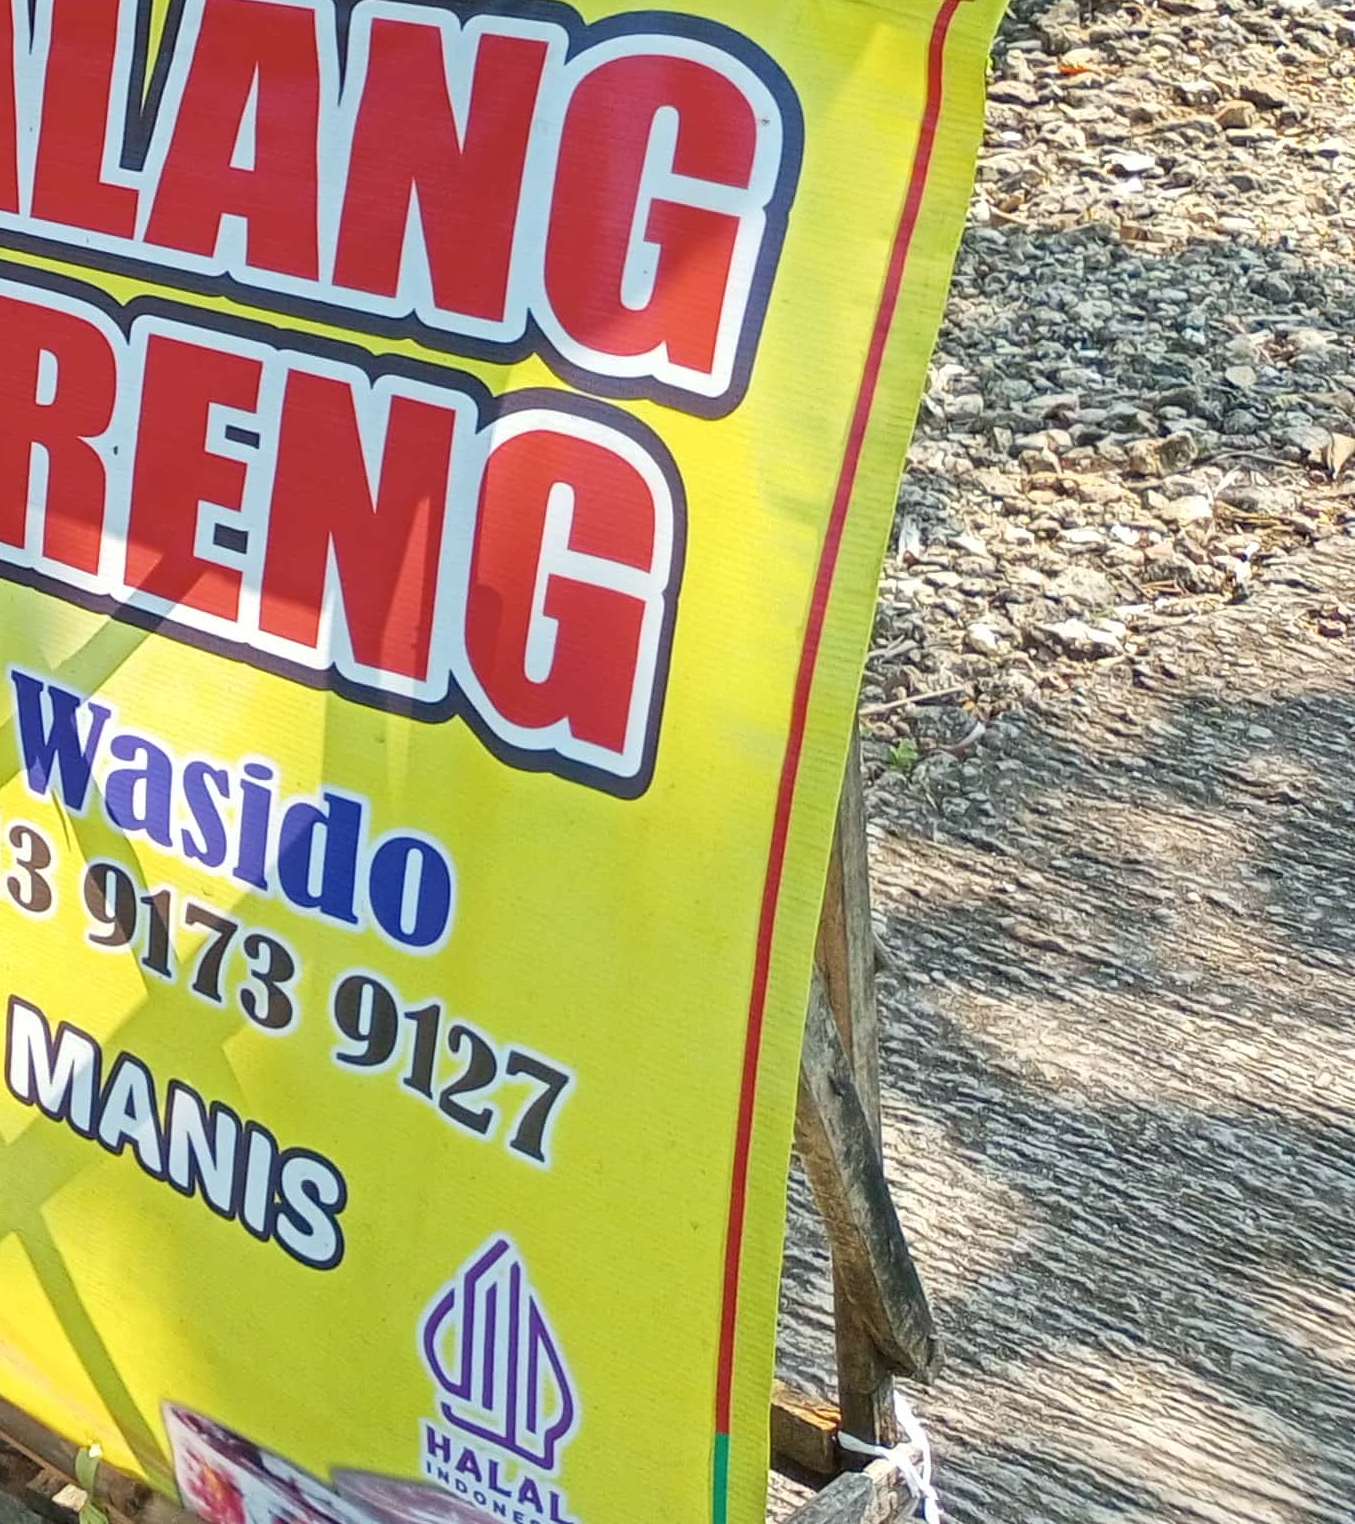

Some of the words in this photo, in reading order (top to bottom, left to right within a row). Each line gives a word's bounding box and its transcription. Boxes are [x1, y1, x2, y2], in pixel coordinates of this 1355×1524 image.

[11, 669, 452, 949] Wasido
[5, 997, 346, 1267] MANIS
[85, 863, 295, 1030] 9173
[335, 975, 571, 1164] 9127
[426, 1425, 575, 1524] HALAL
